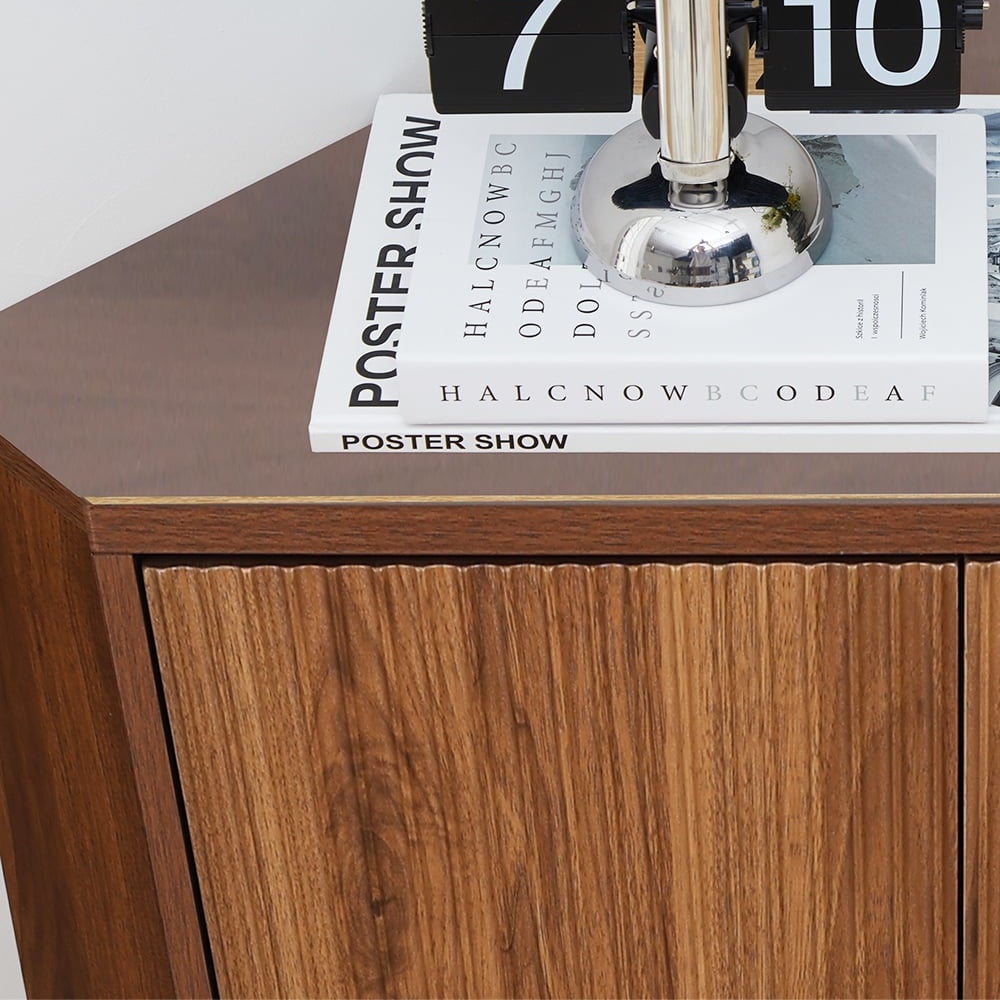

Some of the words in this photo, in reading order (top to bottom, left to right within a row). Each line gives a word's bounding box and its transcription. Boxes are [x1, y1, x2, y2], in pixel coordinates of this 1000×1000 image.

[385, 115, 441, 230] SHOW
[341, 434, 466, 450] POSTER
[475, 433, 568, 450] SHOW
